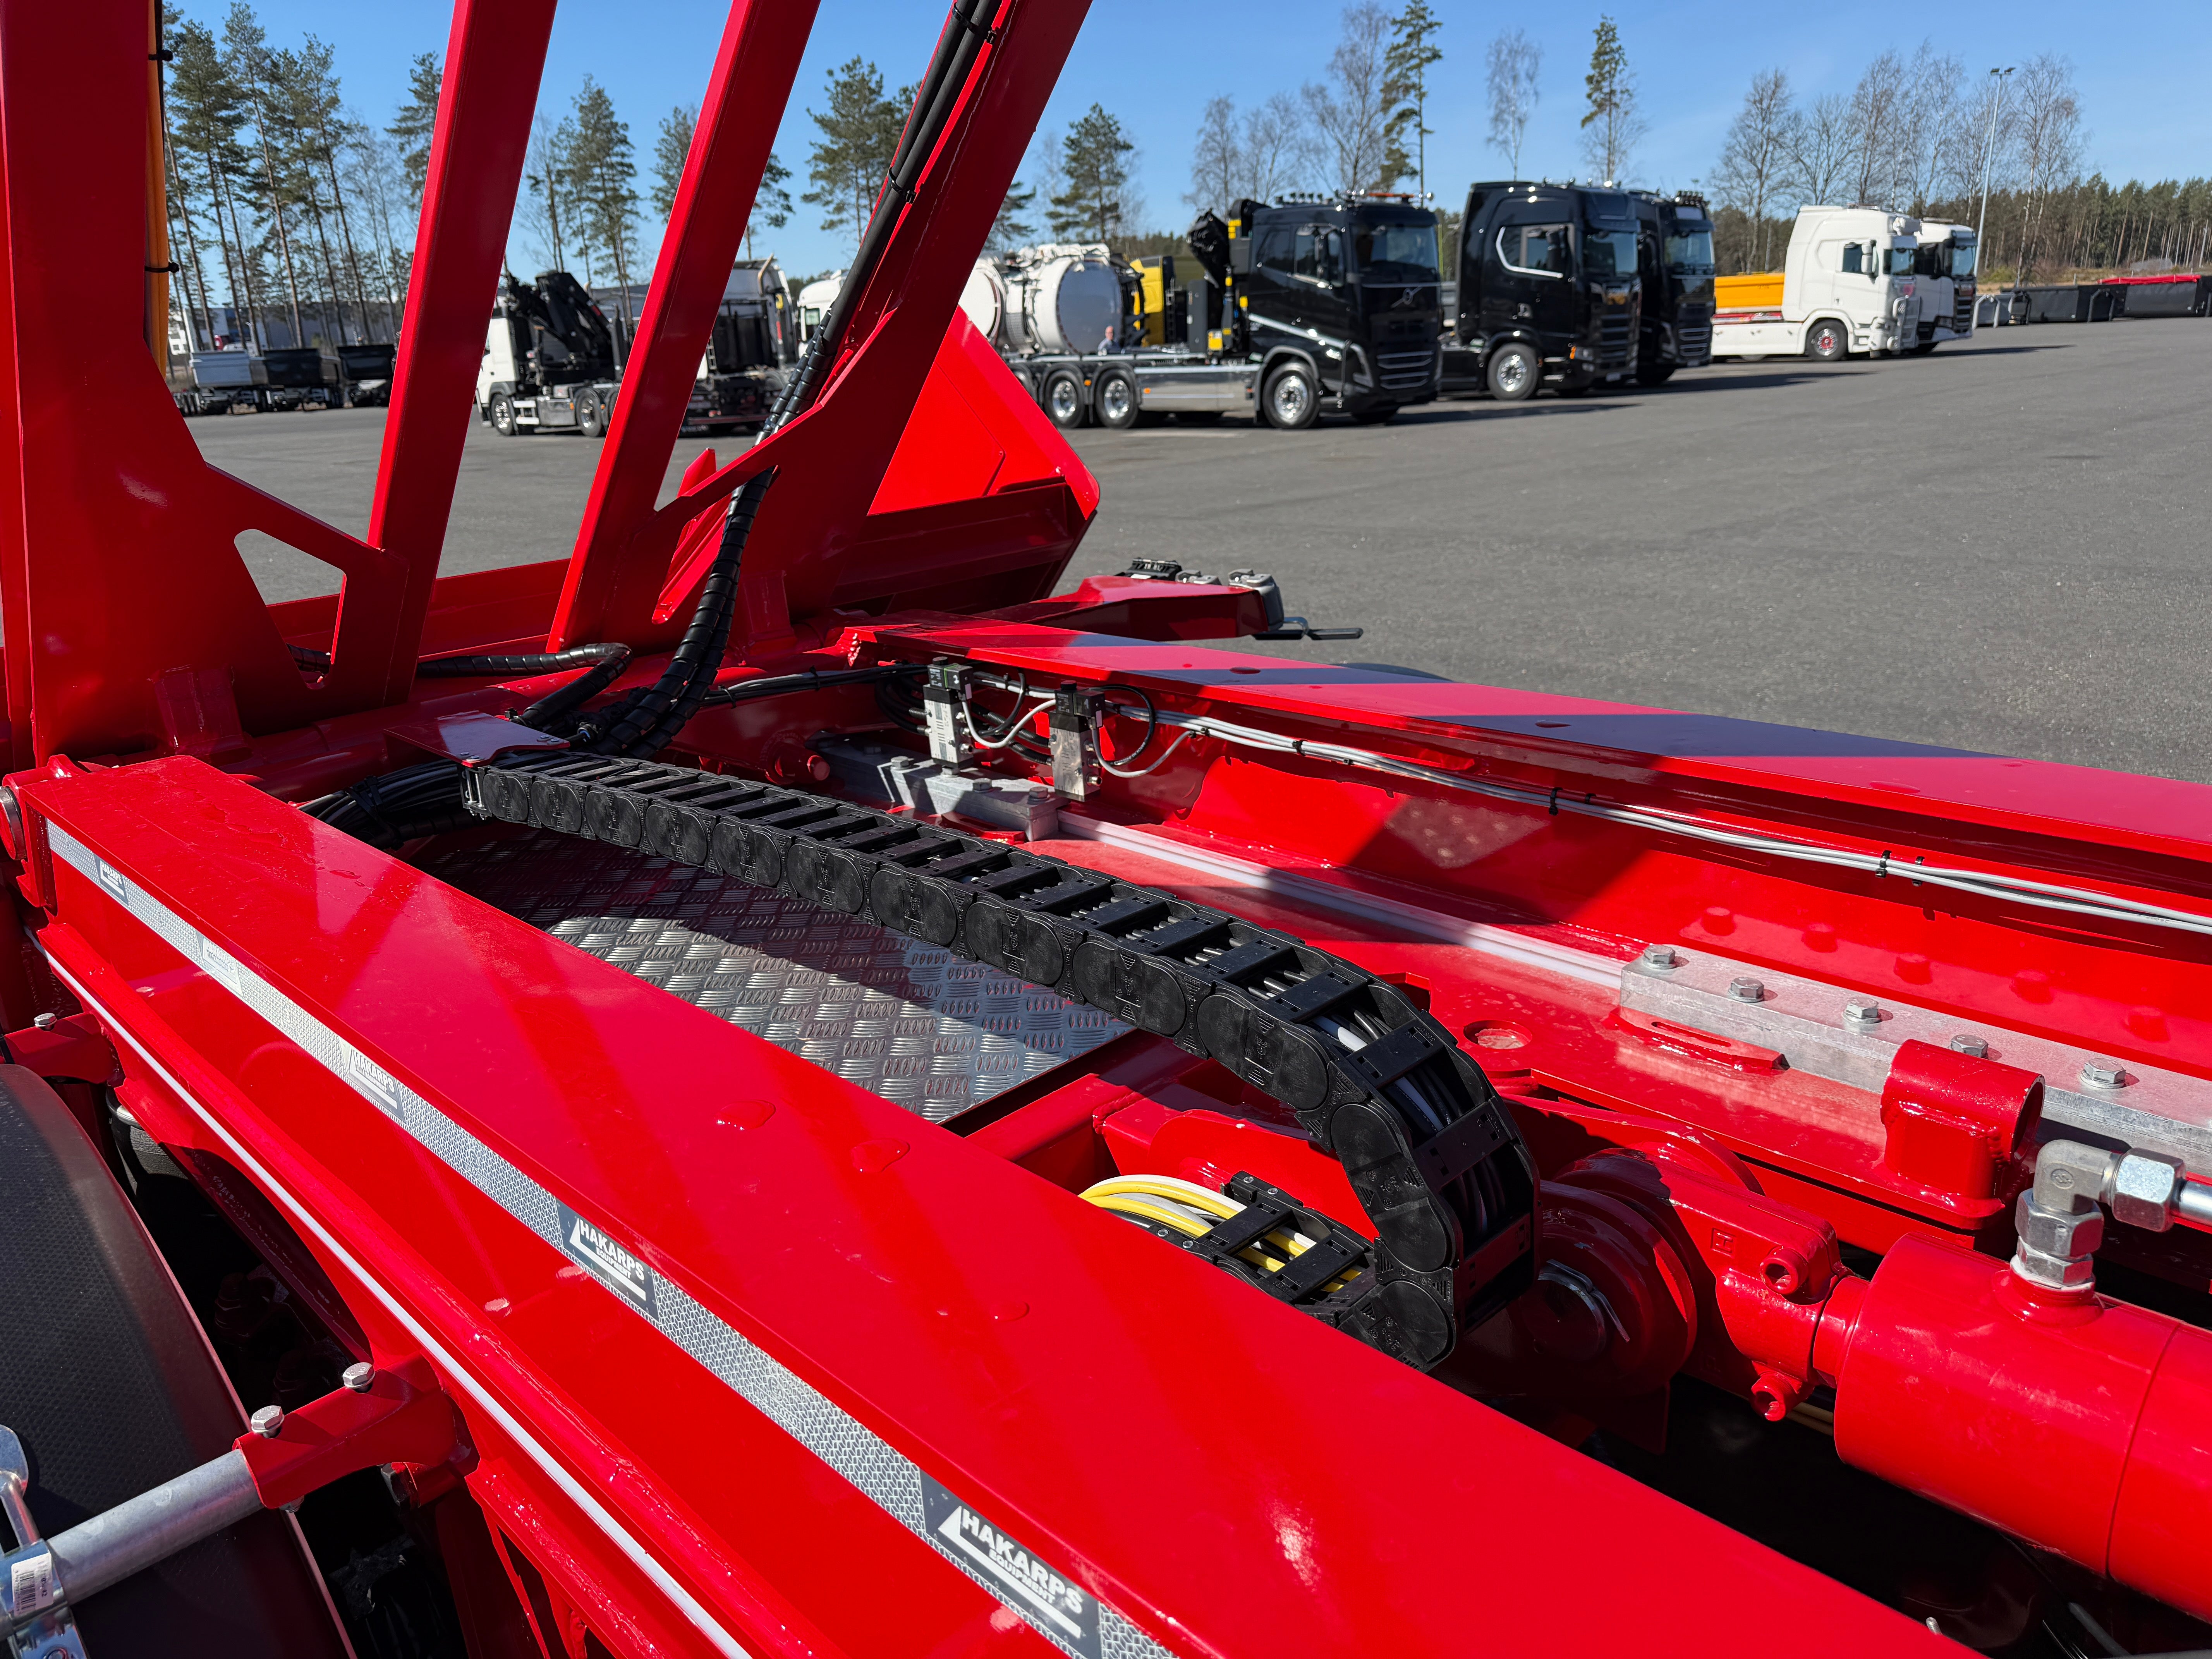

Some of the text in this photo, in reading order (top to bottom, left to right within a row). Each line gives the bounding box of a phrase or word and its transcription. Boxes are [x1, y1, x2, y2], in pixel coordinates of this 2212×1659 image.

[354, 1050, 395, 1093] HAKARPS
[580, 1219, 644, 1280] HAKARPS
[596, 1247, 631, 1278] EQUIPMENT
[962, 1508, 1083, 1614] HAKARPS
[988, 1549, 1055, 1604] EQUIPMENT
